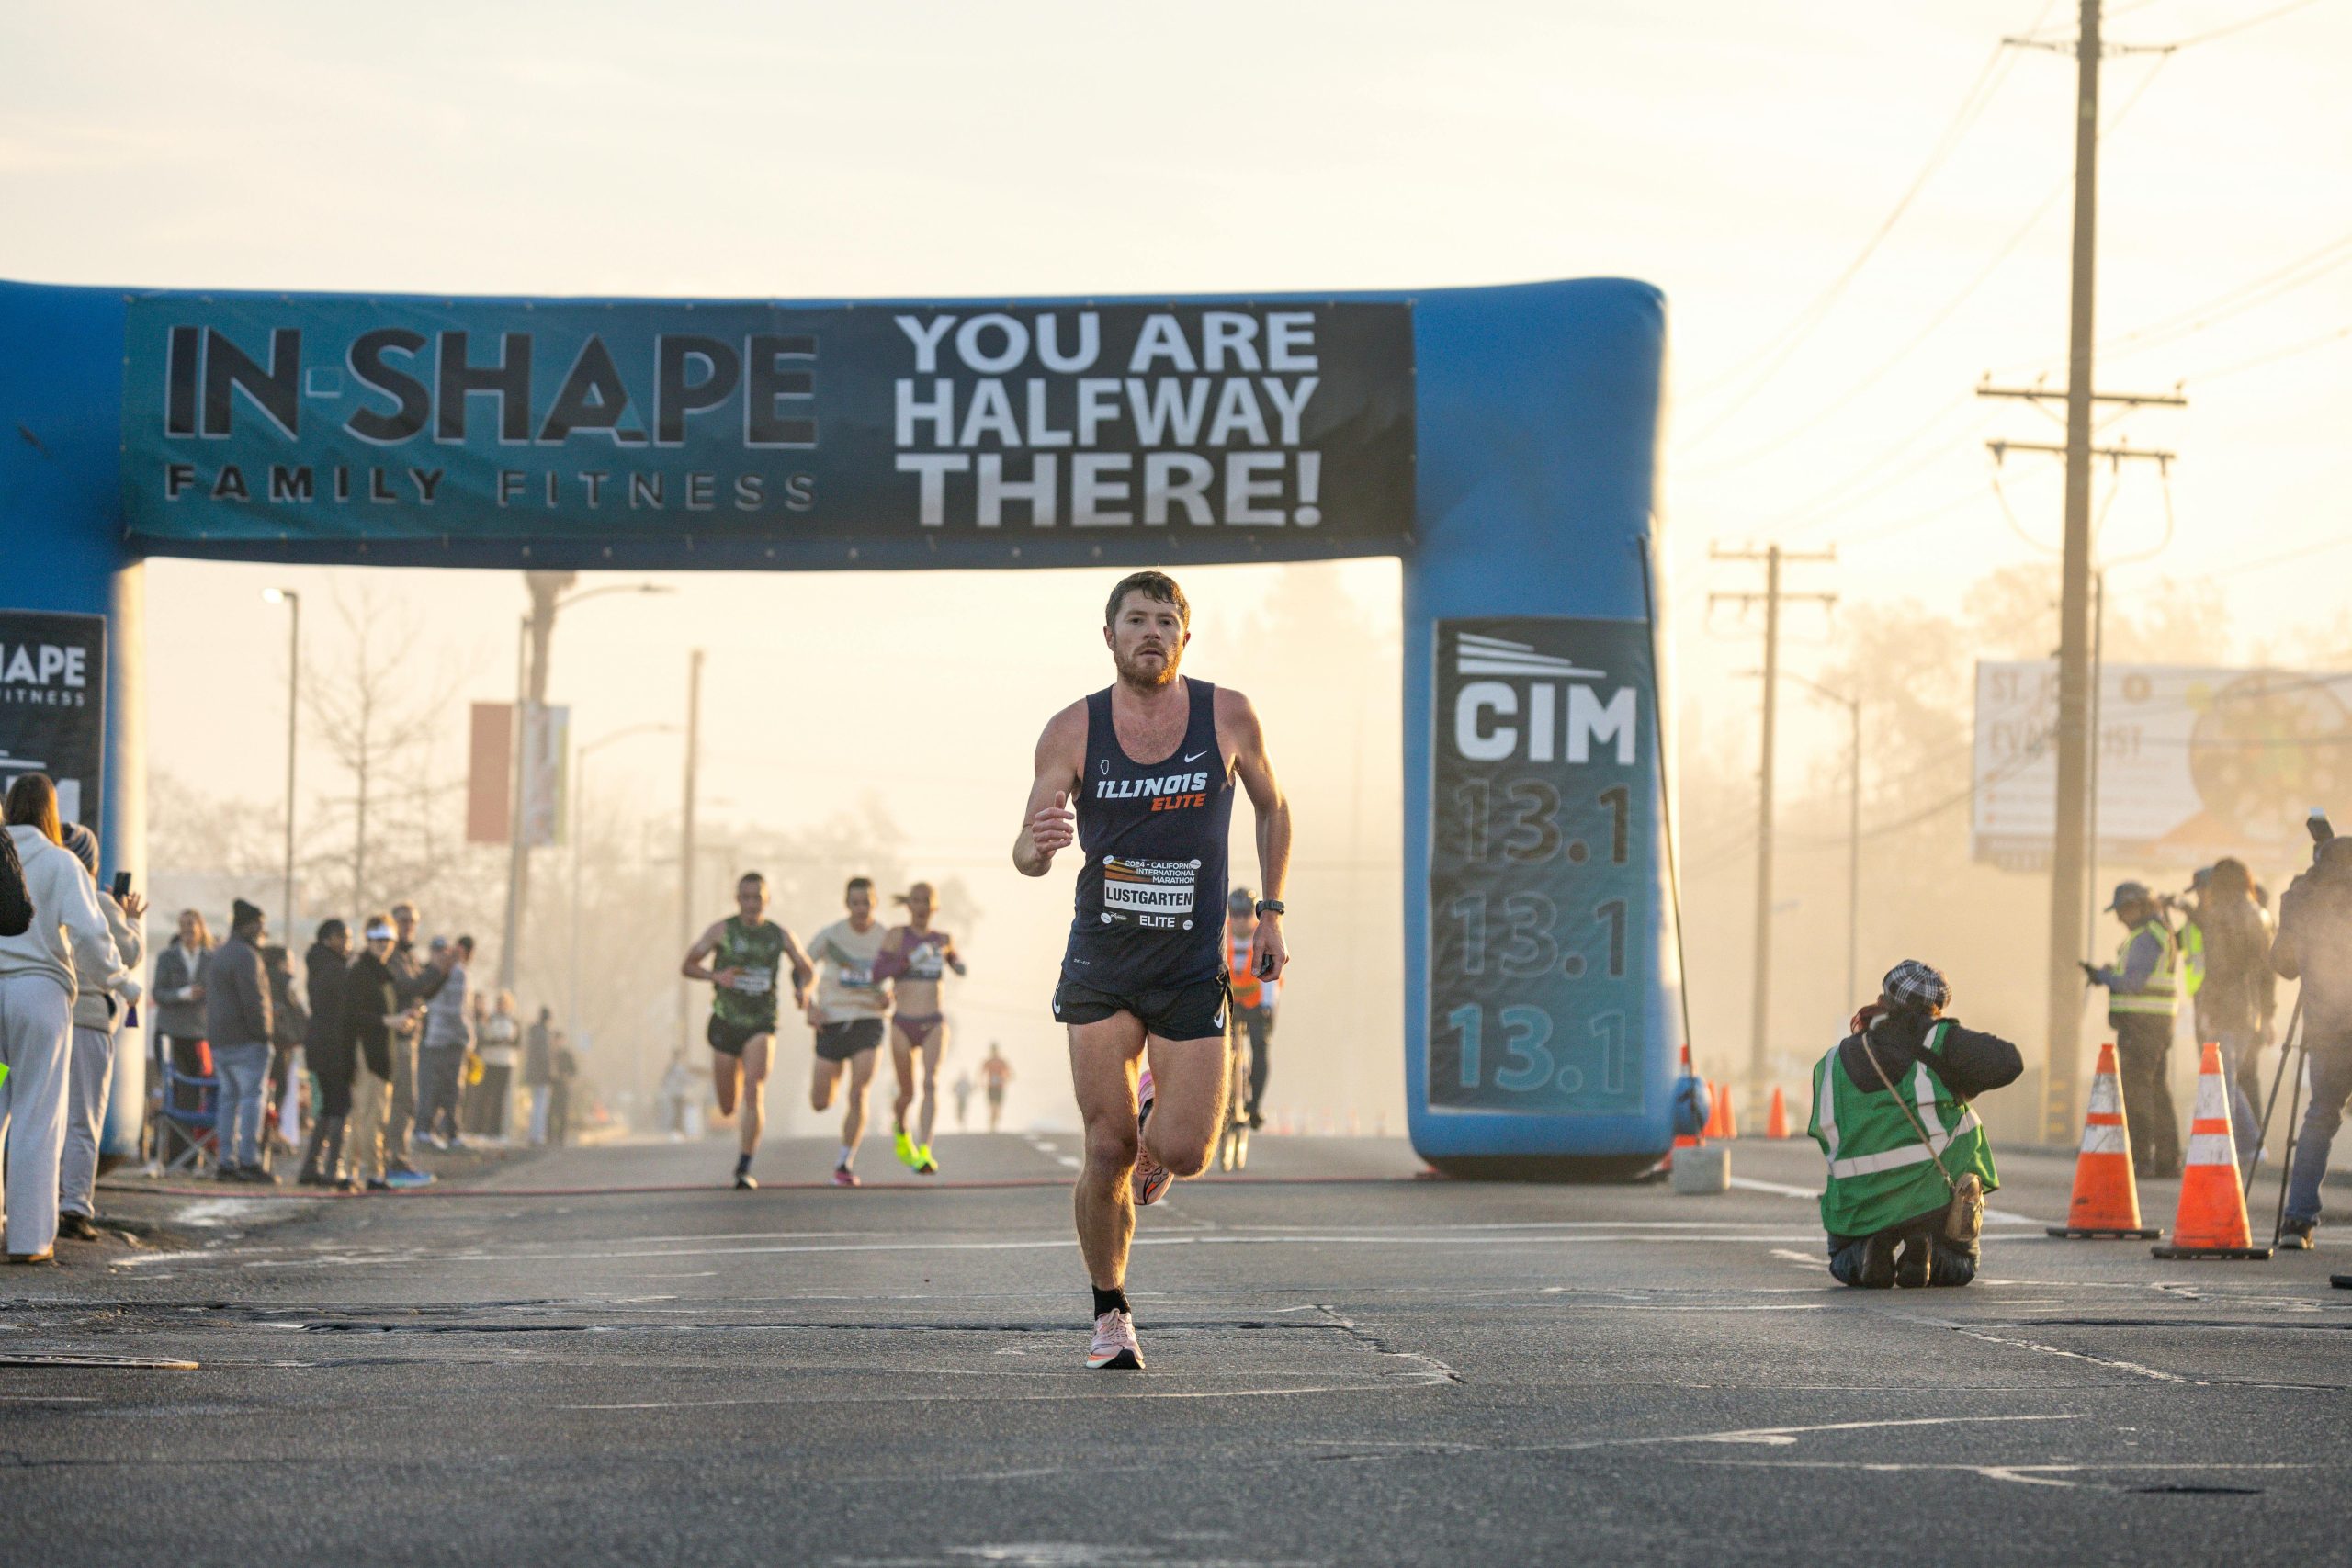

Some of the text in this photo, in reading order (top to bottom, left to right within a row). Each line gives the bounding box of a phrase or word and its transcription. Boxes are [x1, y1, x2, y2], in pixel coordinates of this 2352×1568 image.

[894, 312, 1318, 374] YOU ARE
[164, 325, 818, 448] IN-SHAPE
[894, 377, 1320, 447] HALFWAY
[164, 464, 816, 511] FAMILY FITNESS
[894, 451, 1321, 527] THERE!
[0, 642, 86, 687] APE
[0, 687, 85, 707] ITNESS
[1455, 681, 1637, 765] CIM
[1097, 772, 1207, 798] ILLINOIS
[1151, 793, 1206, 812] ELITE
[1456, 779, 1630, 864] 13.1
[1125, 860, 1145, 868] 2024
[1136, 868, 1194, 876] INTERNATIONAL
[1106, 886, 1193, 906] LUSTGARTEN
[1139, 915, 1175, 928] ELITE
[1453, 889, 1629, 979] 13.1
[1448, 1002, 1626, 1094] 13.1
